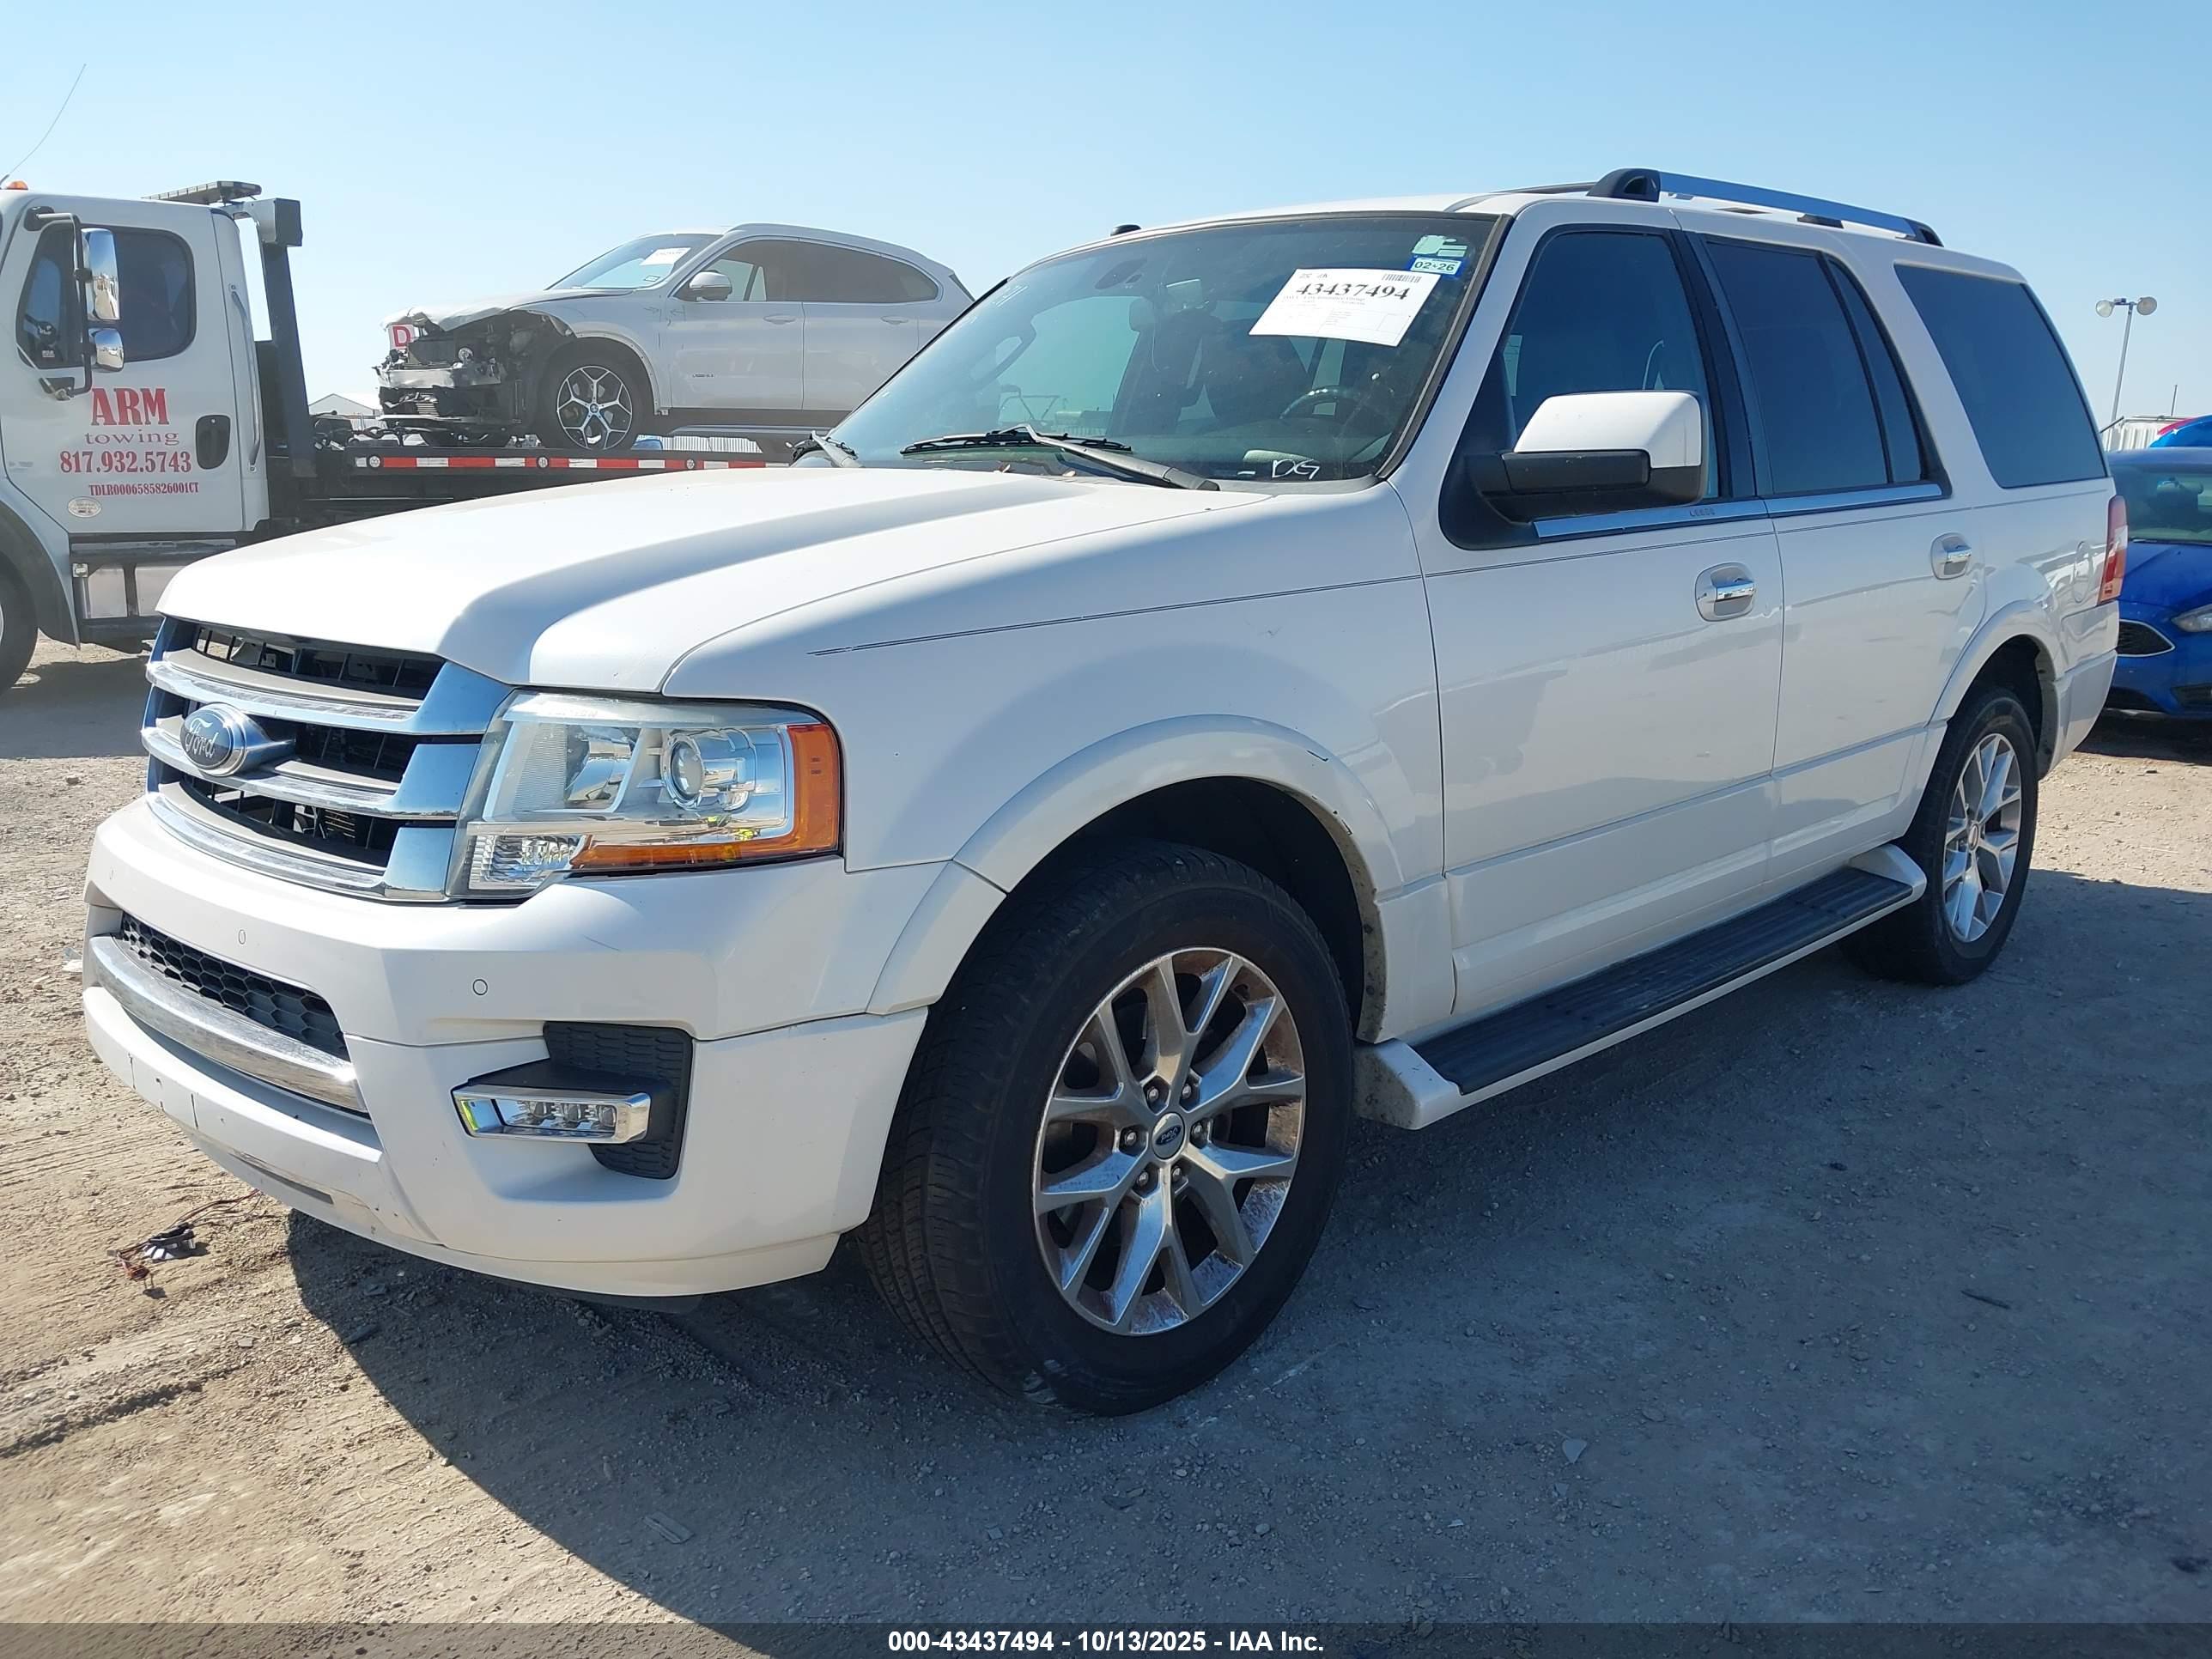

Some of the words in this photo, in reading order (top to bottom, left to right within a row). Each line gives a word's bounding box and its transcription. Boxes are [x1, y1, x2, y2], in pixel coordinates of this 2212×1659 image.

[1296, 283, 1411, 301] 43437494
[91, 388, 170, 426] ARM
[84, 429, 179, 447] towing
[59, 450, 191, 473] 817.932.5743
[185, 717, 220, 759] Ford
